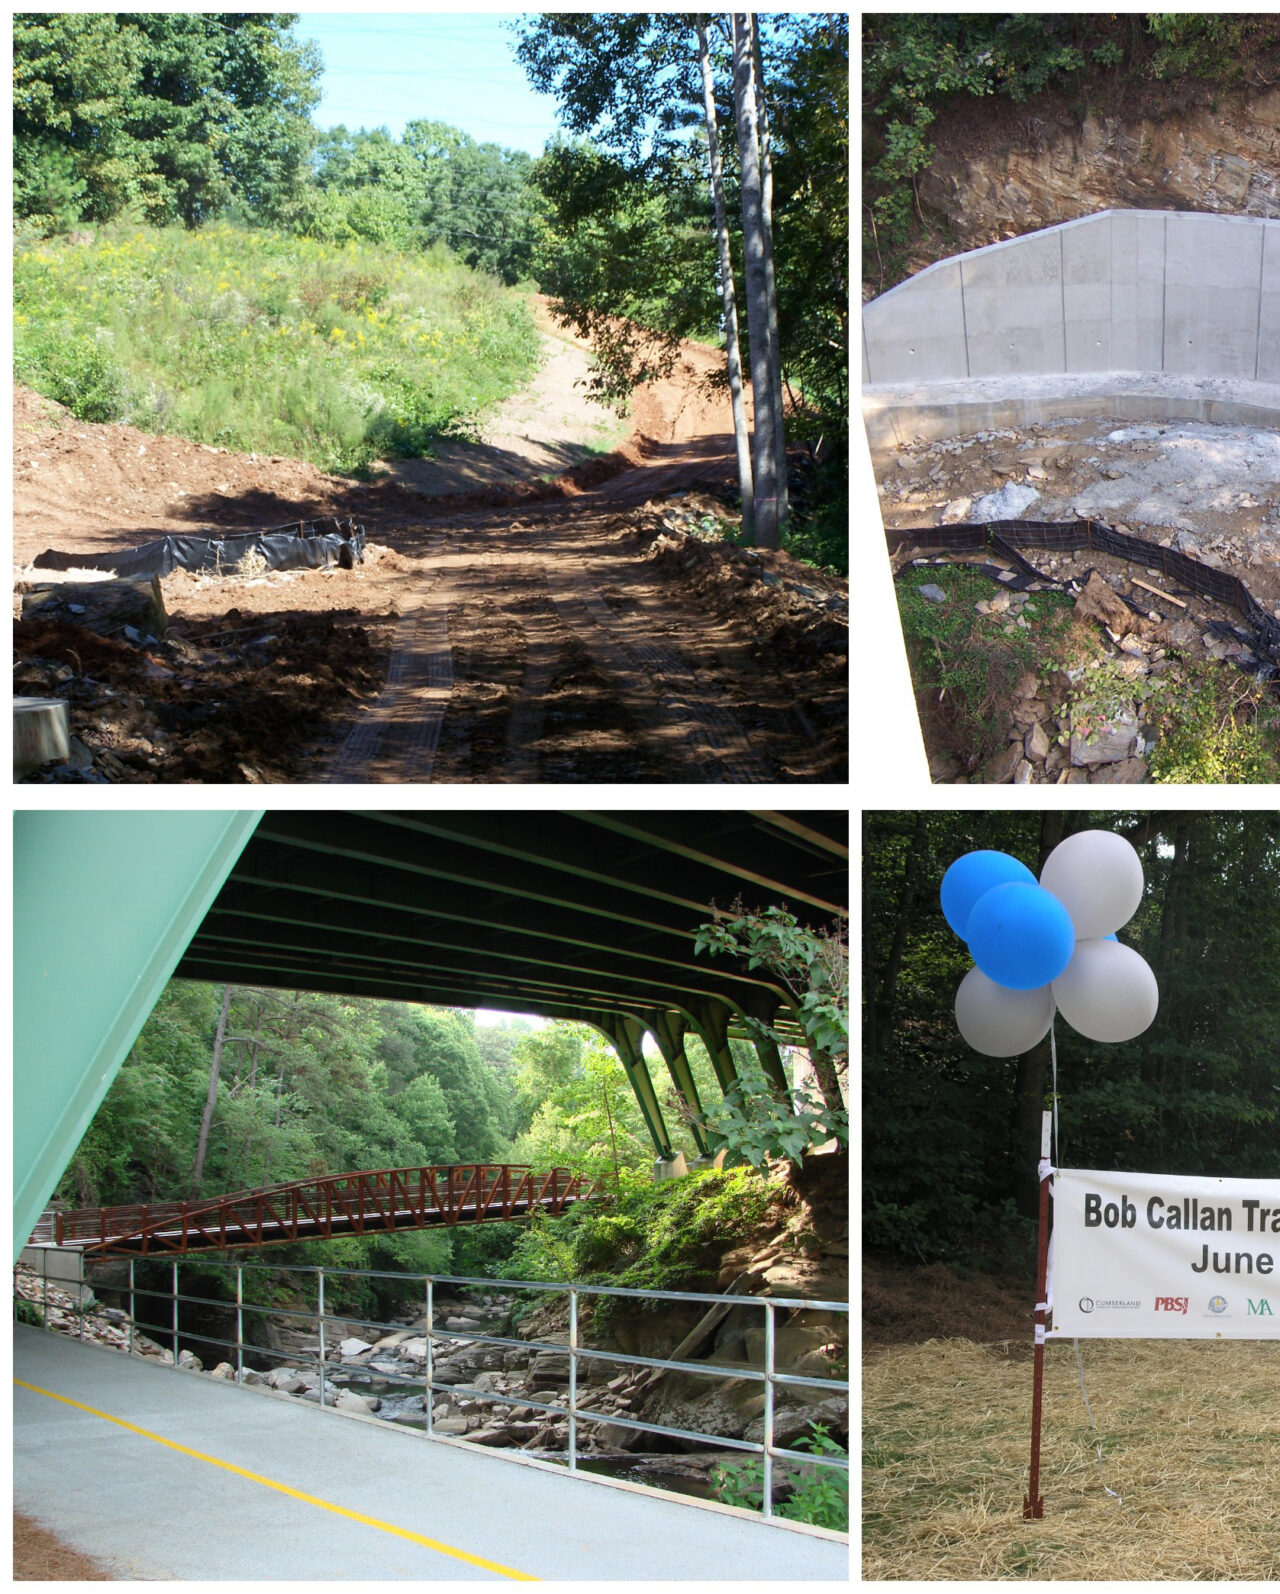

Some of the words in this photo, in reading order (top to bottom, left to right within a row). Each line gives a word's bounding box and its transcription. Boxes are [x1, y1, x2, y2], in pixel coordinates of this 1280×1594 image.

[1084, 1193, 1137, 1229] Bob
[1147, 1195, 1232, 1231] Callan
[1190, 1244, 1274, 1275] June
[1247, 1298, 1274, 1316] MA
